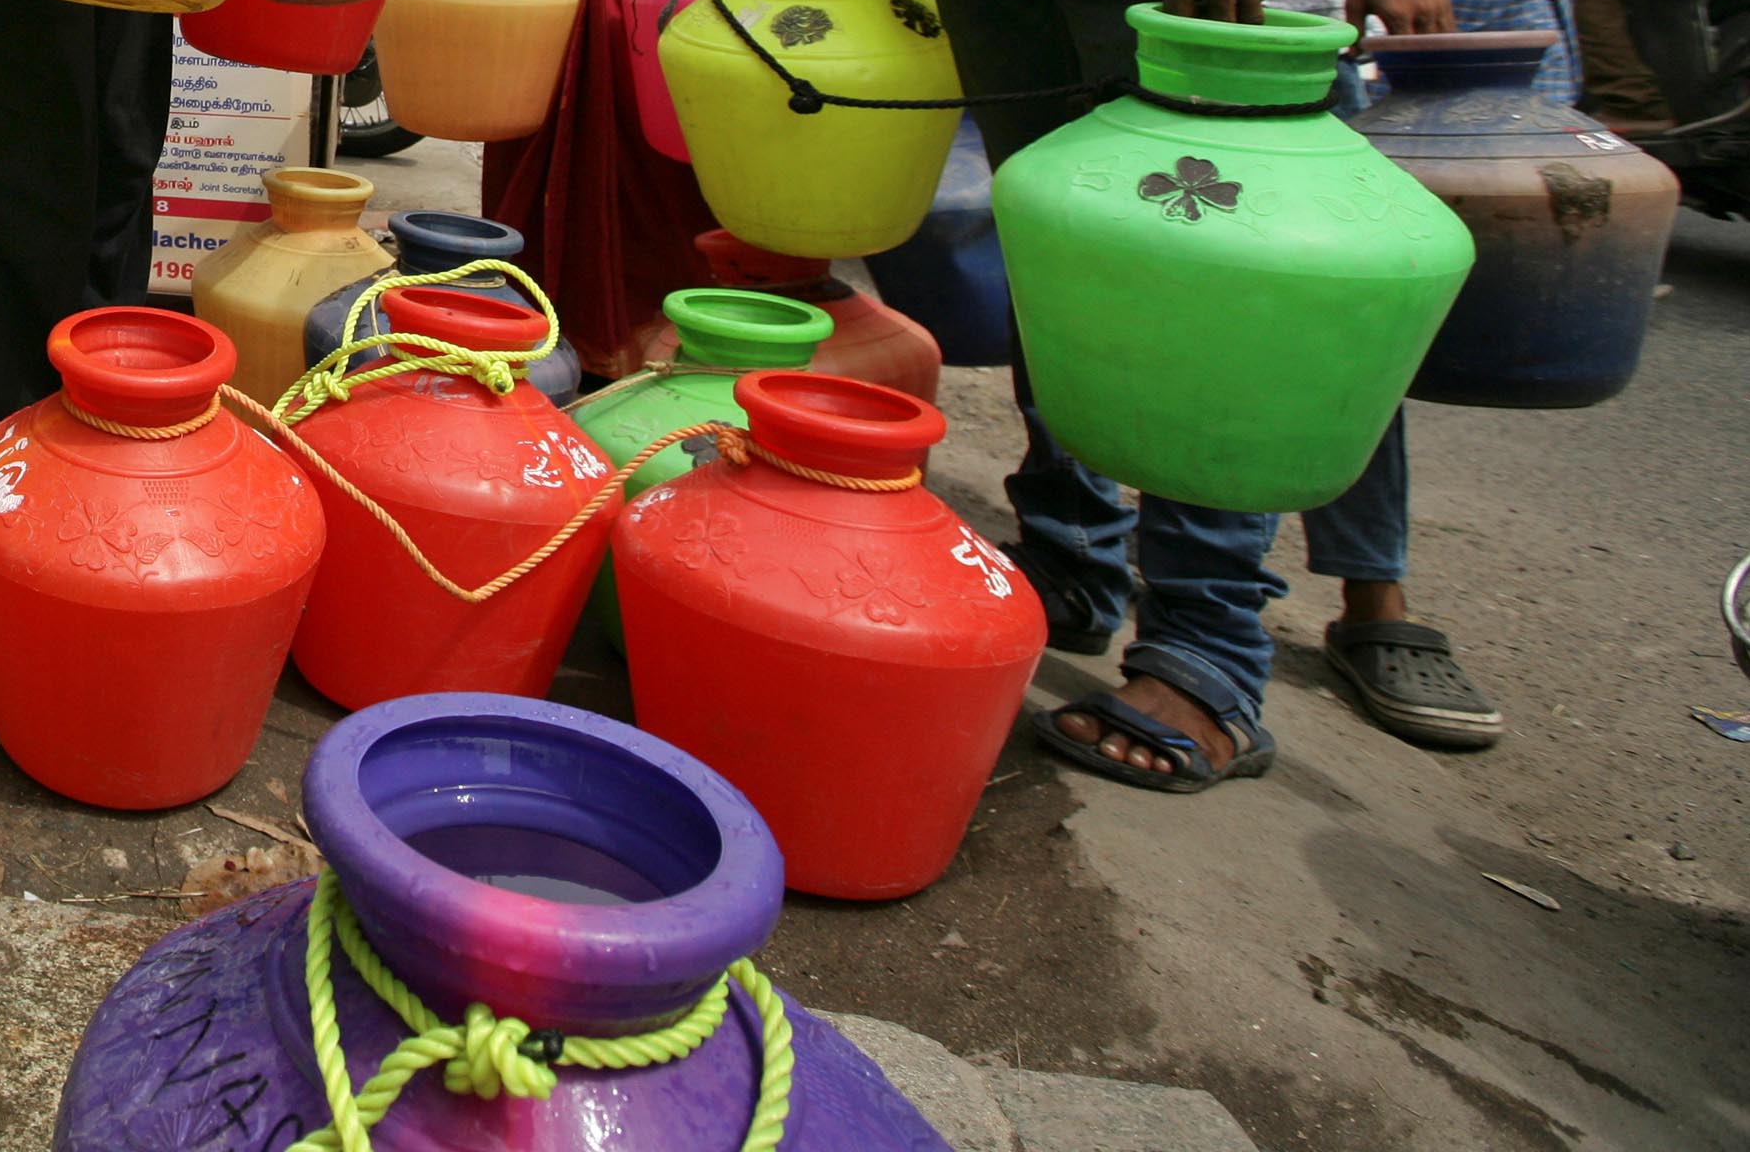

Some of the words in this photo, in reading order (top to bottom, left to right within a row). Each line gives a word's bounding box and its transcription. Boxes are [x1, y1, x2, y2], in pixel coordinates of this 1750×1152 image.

[199, 182, 220, 193] Joint
[222, 183, 265, 197] Secretary
[156, 200, 169, 212] 8
